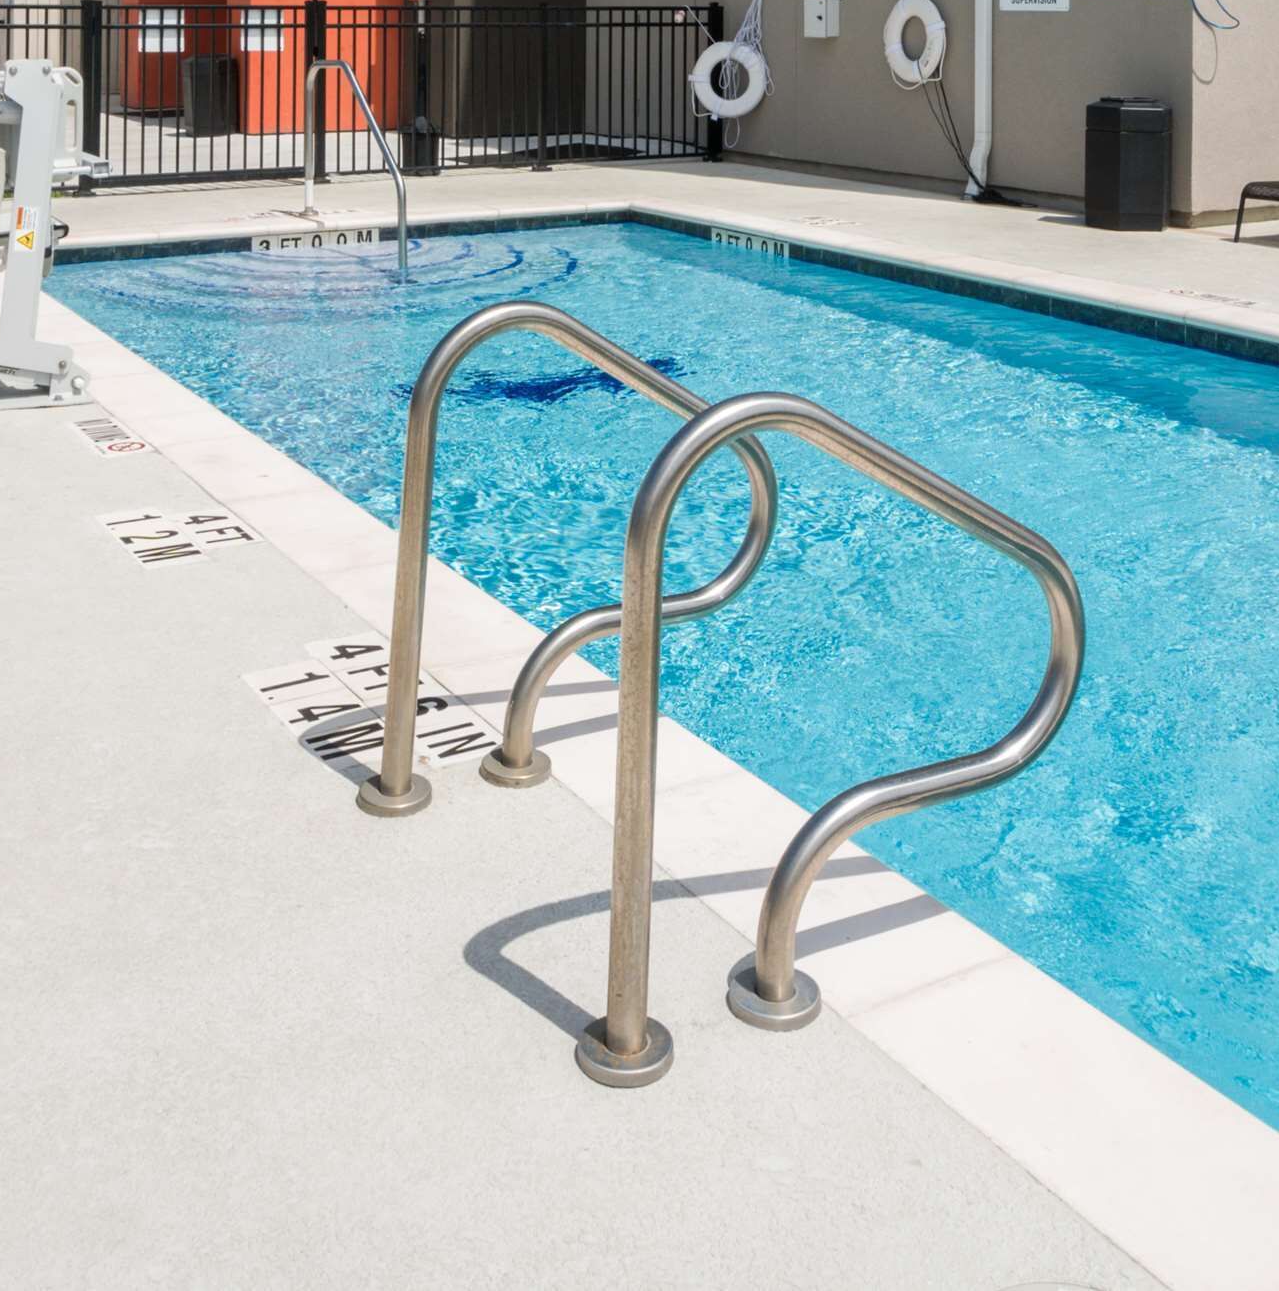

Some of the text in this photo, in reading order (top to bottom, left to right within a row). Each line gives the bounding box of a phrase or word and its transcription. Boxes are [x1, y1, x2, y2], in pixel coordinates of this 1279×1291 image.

[184, 515, 254, 544] 4 FT
[330, 644, 384, 660] 4
[416, 722, 497, 759] IN
